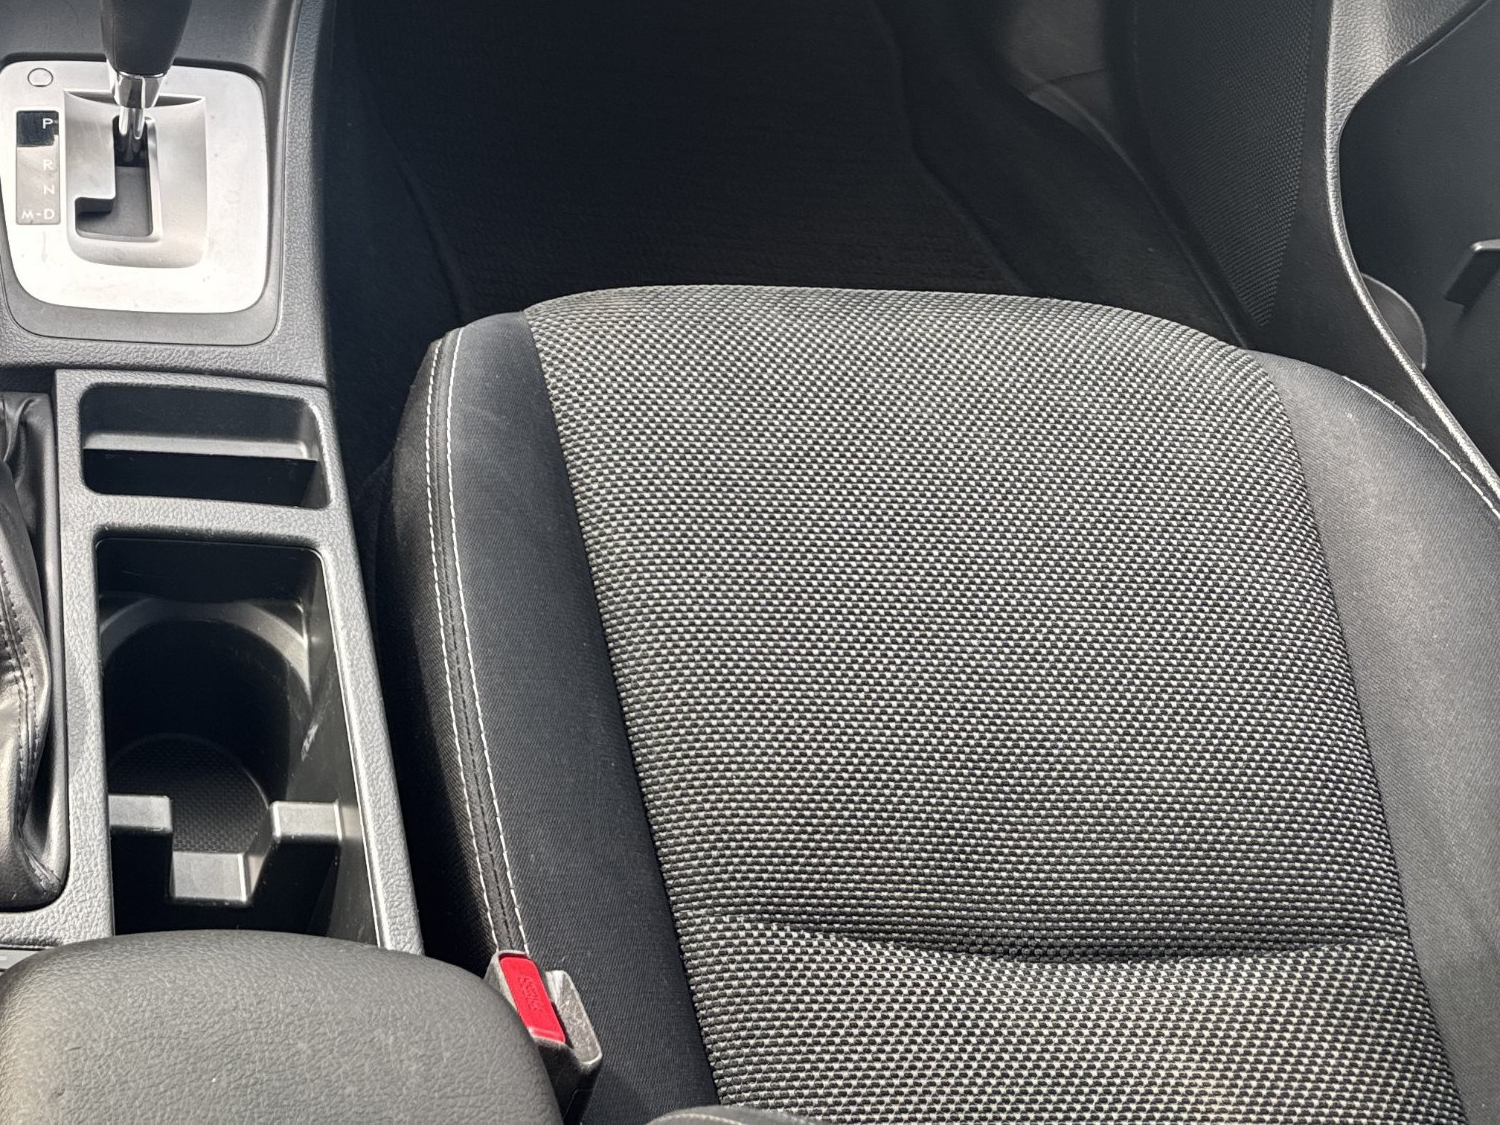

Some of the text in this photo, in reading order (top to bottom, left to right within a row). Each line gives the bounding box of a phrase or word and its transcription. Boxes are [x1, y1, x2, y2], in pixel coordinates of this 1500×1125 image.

[42, 118, 53, 129] P
[43, 159, 53, 171] R
[43, 185, 55, 195] N
